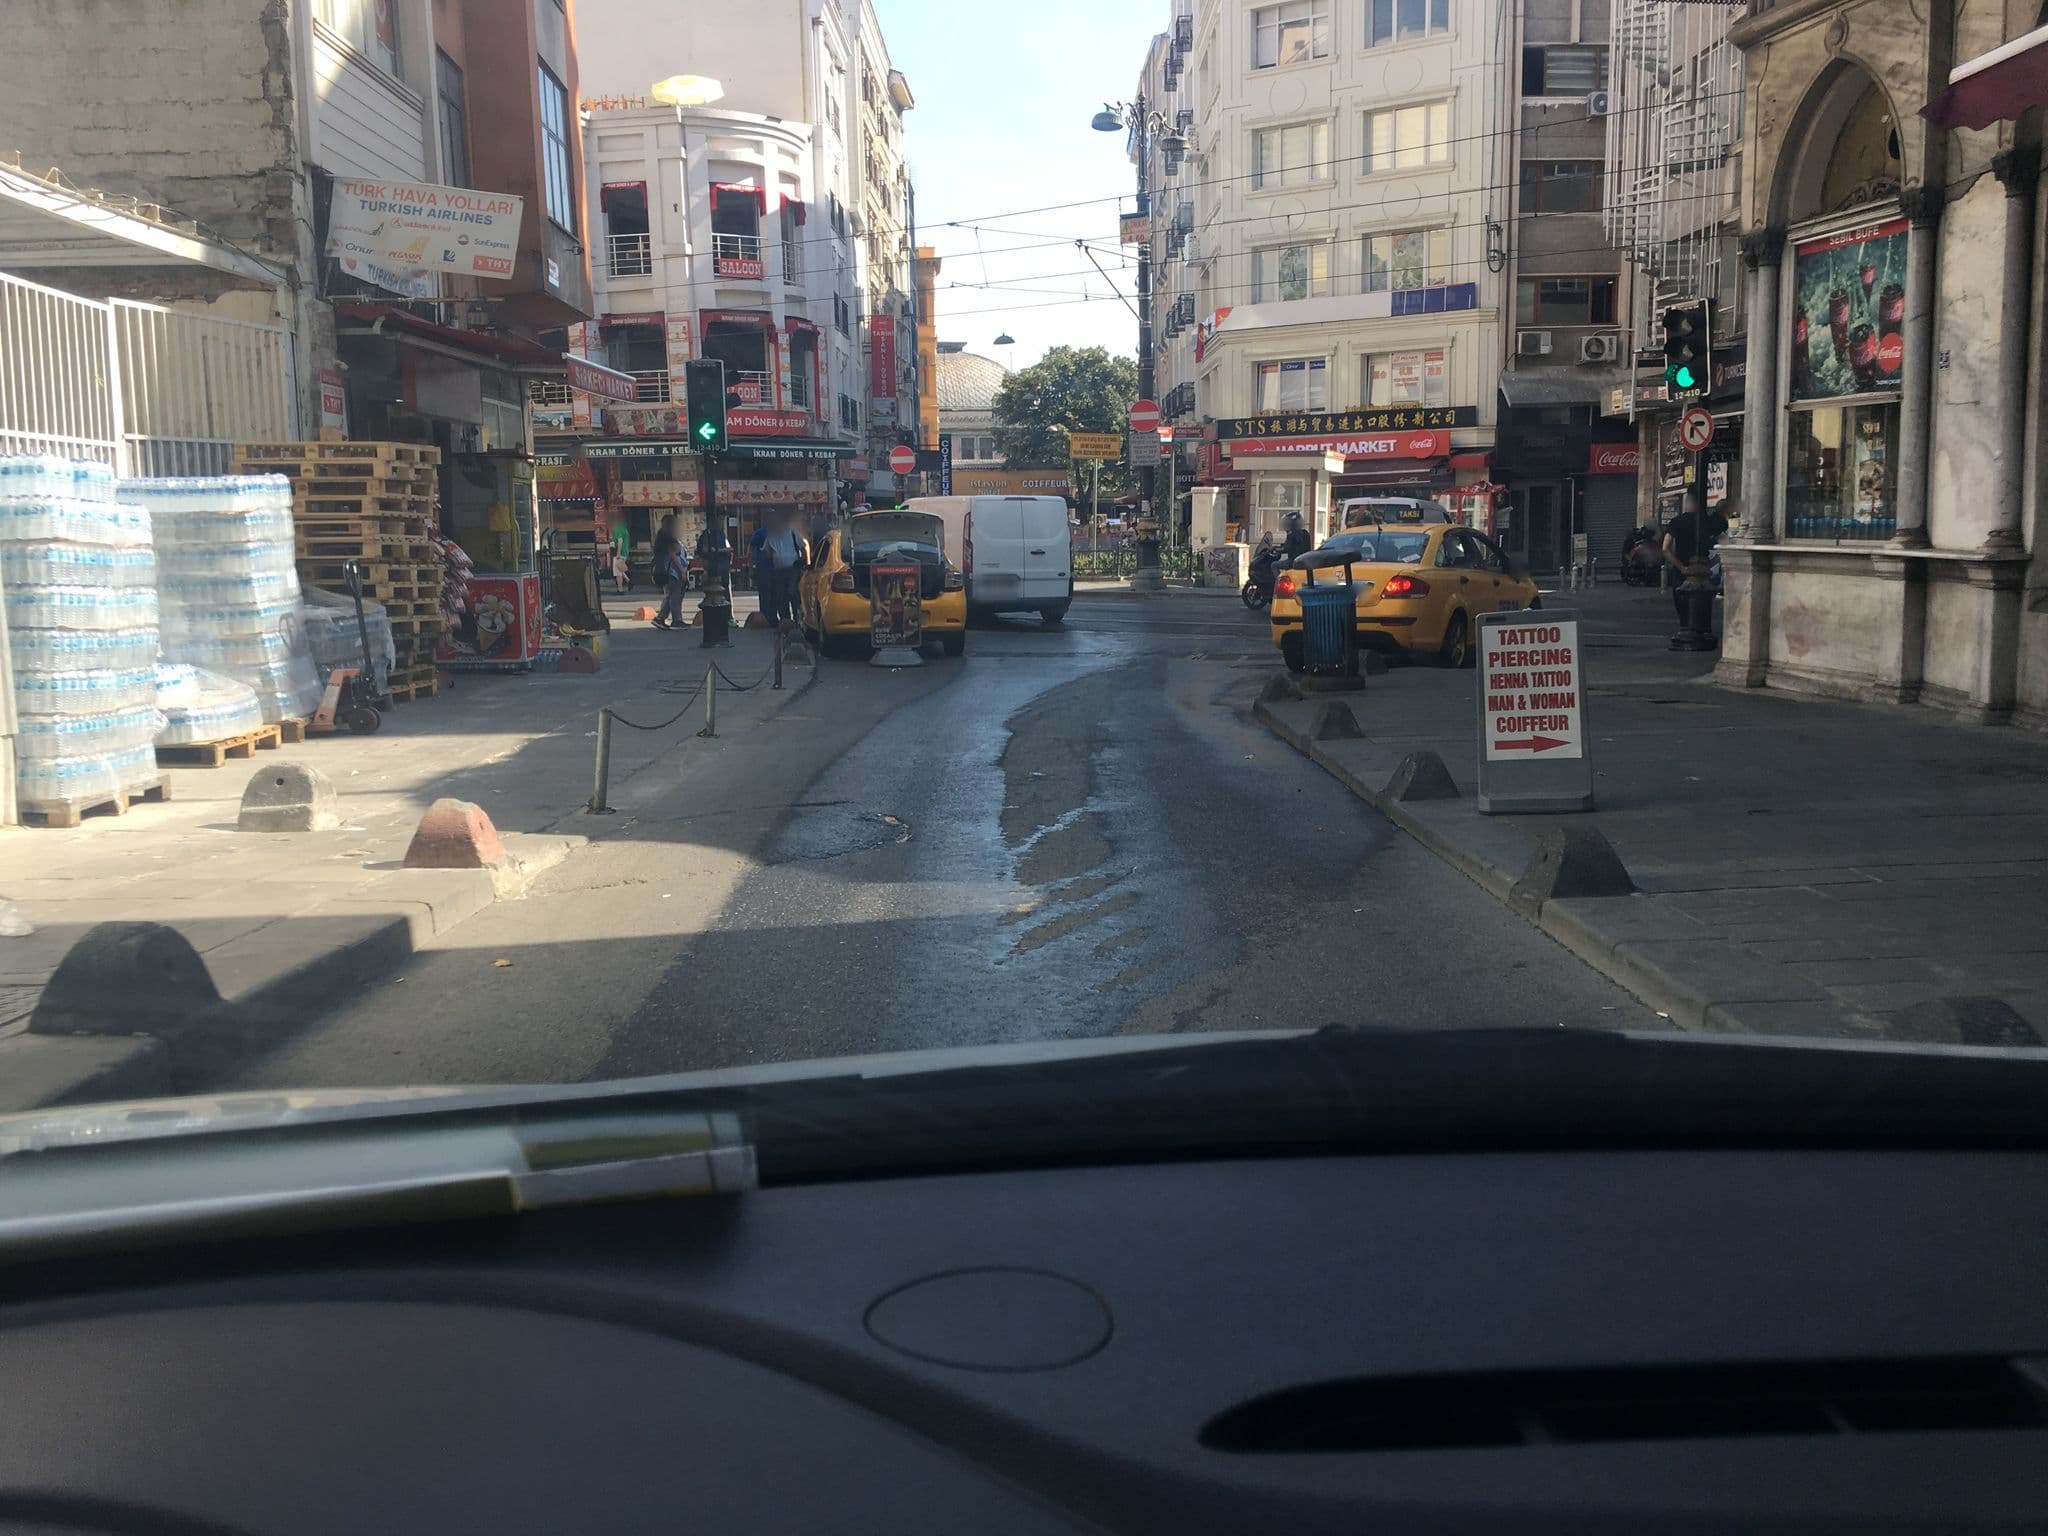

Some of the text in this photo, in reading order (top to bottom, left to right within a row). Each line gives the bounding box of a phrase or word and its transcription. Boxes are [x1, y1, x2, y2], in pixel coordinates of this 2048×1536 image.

[344, 180, 513, 215] TÜRK HAVA YOLLARI
[360, 200, 493, 225] TURKISH AIRLINES
[474, 237, 510, 249] SunExpress
[487, 257, 511, 269] THY
[721, 261, 763, 276] SALOON
[1675, 388, 1701, 400] 12-410
[745, 416, 777, 427] DÖNER
[778, 419, 784, 427] &
[1234, 419, 1266, 436] STS
[622, 446, 655, 455] DÖNER
[662, 446, 669, 454] &
[780, 449, 804, 458] DÖNER
[815, 451, 836, 459] KEBAP
[1336, 440, 1397, 454] MARKET
[1600, 451, 1639, 467] Coca-Cola
[1022, 480, 1070, 488] COIFFEUR
[1498, 627, 1560, 645] TATTOO
[1488, 648, 1571, 668] PIERCING
[1490, 670, 1571, 689] HENNA TATTOO
[1488, 692, 1575, 712] MAN & WOMAN
[1496, 715, 1569, 733] COIFFEUR
